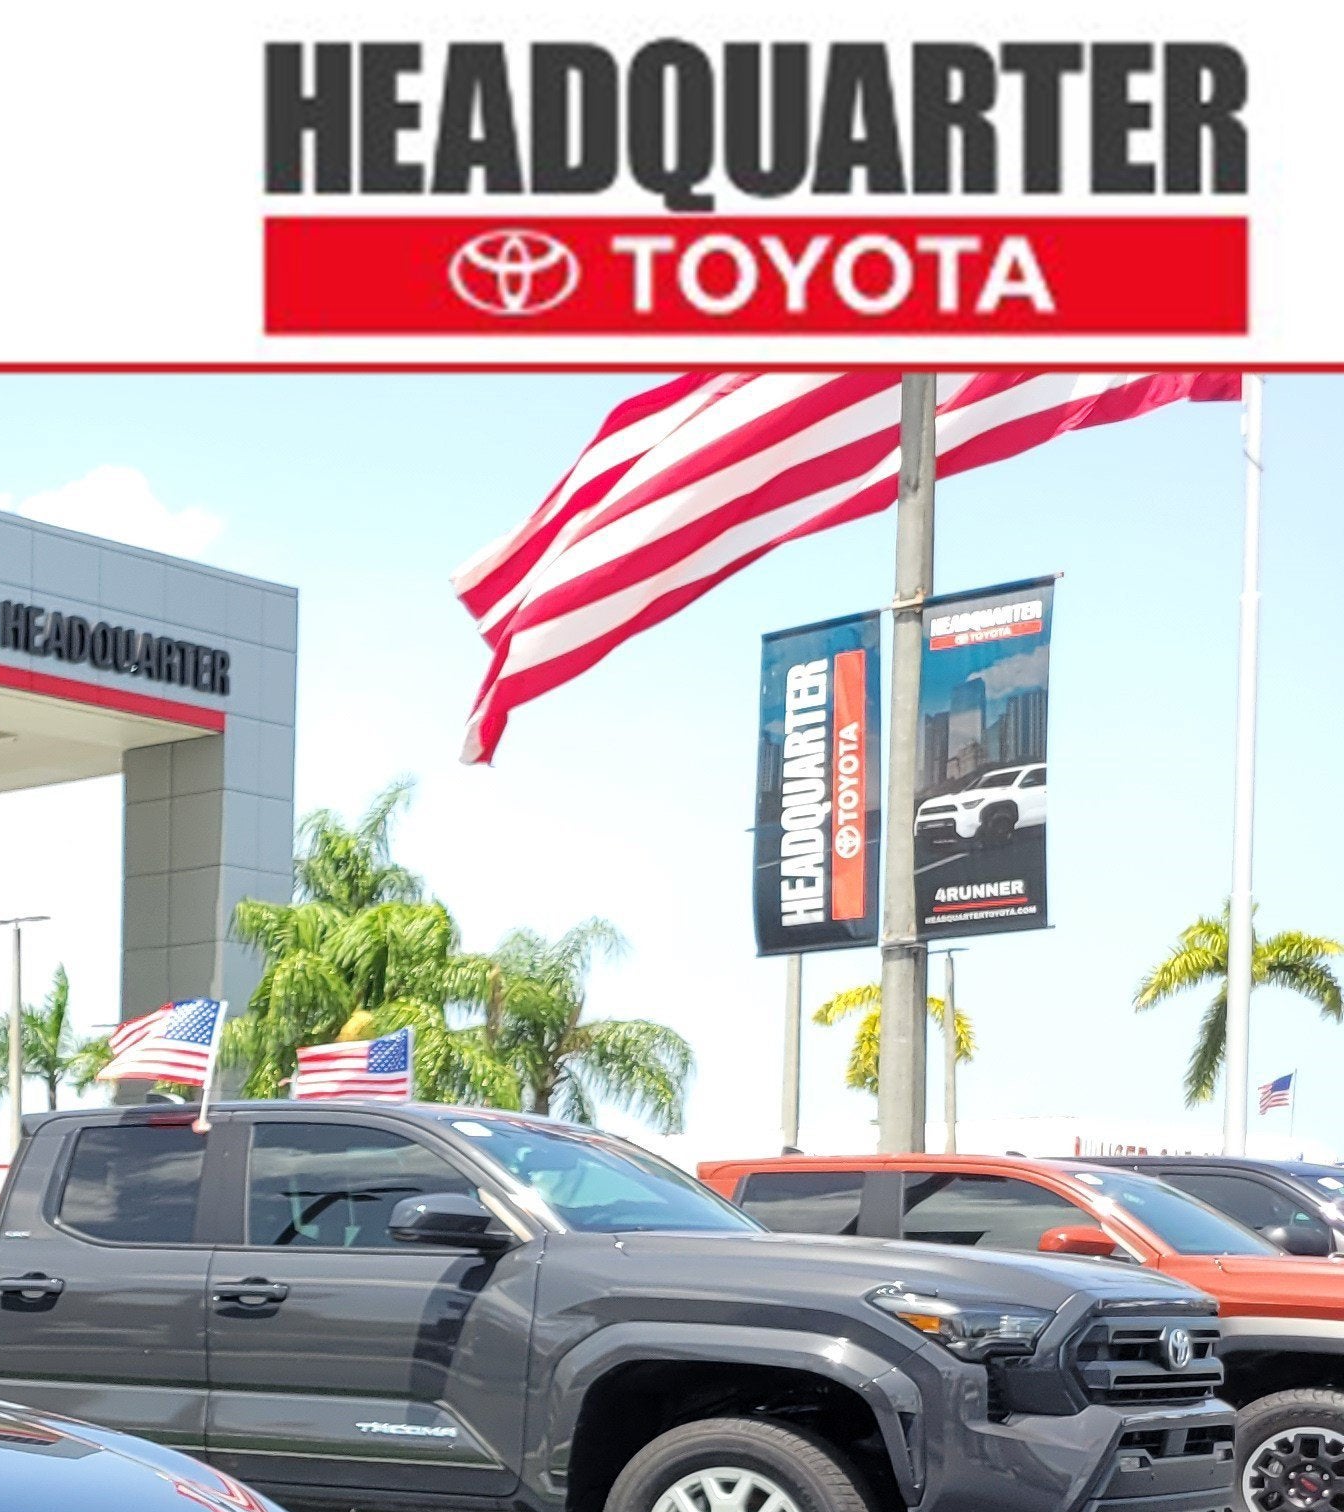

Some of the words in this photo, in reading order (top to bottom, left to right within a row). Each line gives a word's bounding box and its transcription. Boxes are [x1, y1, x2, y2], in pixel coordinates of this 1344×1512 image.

[781, 658, 832, 926] HEADQUARTER
[838, 720, 860, 826] TOYOTA
[925, 905, 1037, 924] HEADQUARTERTOYOTA.COM
[935, 880, 1024, 902] 4RUNNER
